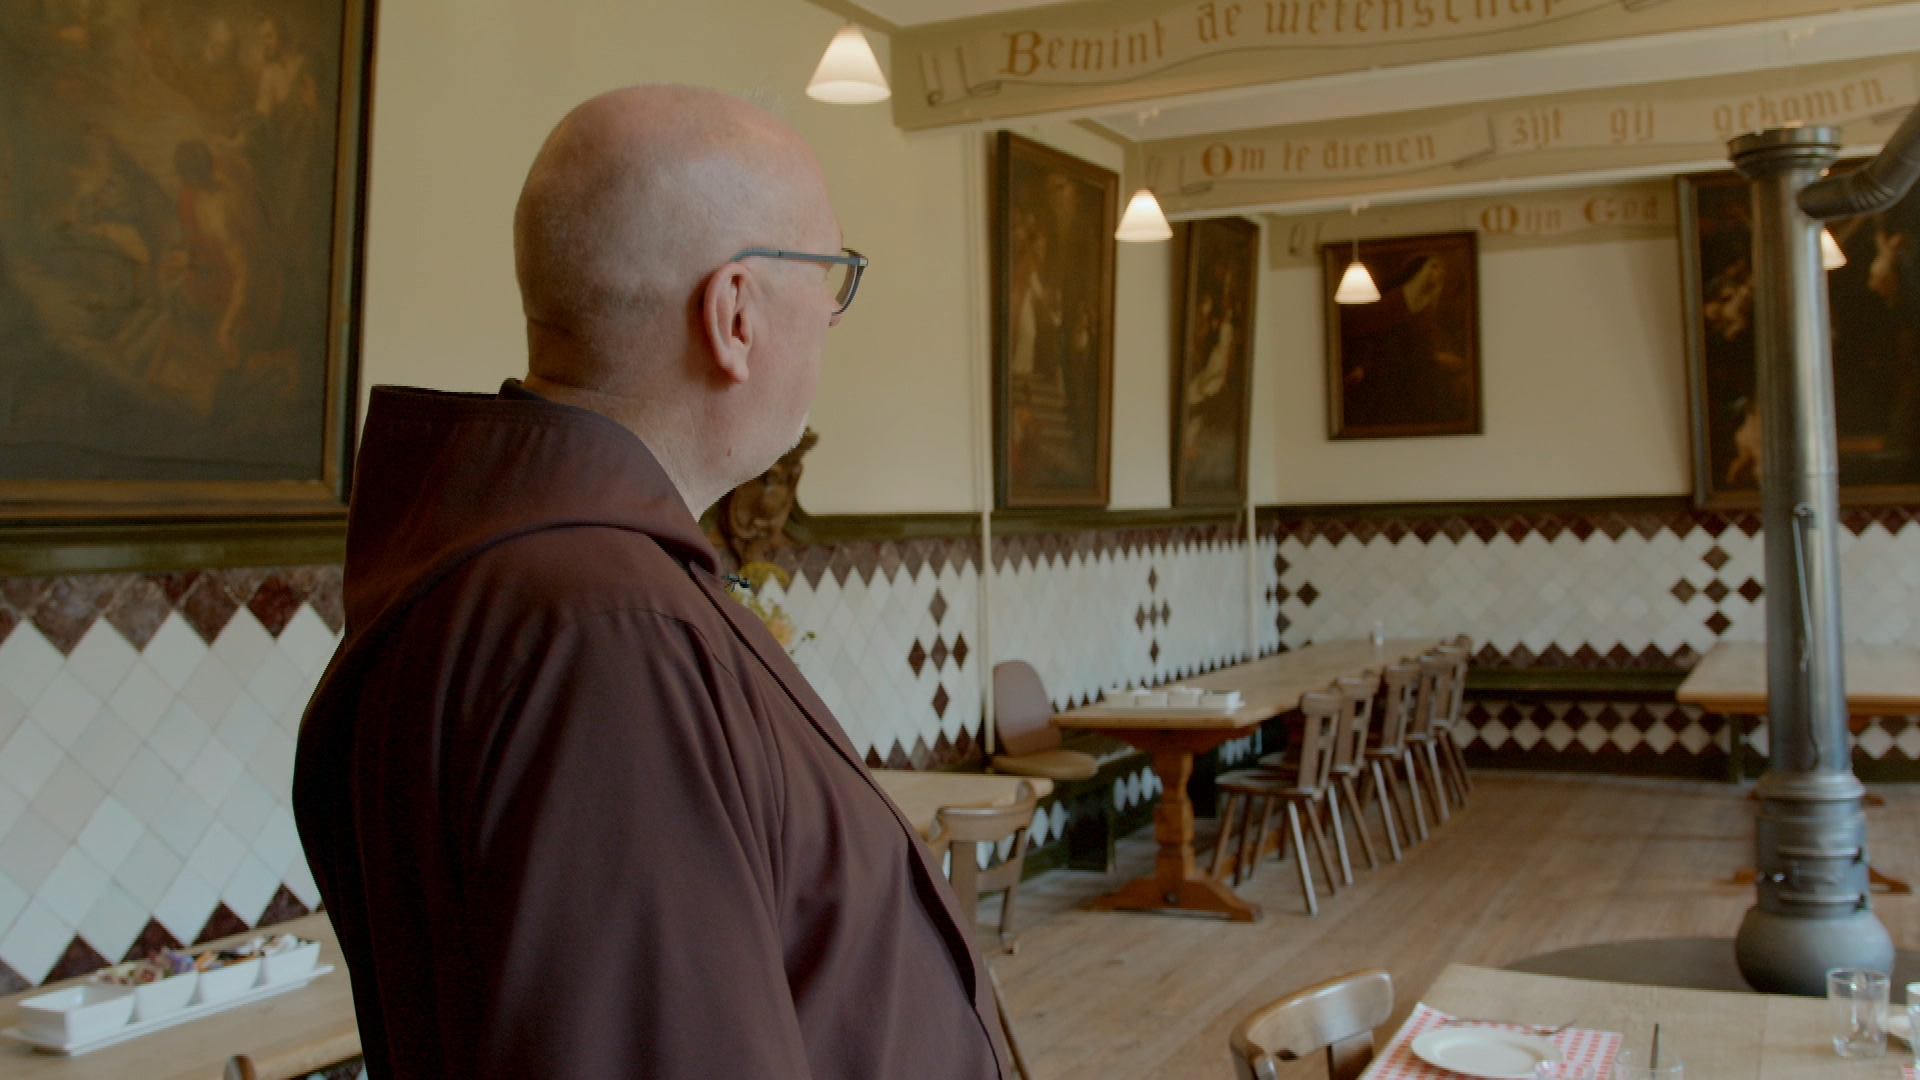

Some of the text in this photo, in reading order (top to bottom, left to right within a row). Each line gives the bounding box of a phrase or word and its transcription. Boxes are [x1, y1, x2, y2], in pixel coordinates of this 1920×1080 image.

[1001, 18, 1166, 77] Bemint
[1196, 0, 1243, 43] de
[1202, 141, 1266, 178] Om
[1283, 141, 1311, 172] te
[1322, 133, 1436, 171] dienen
[1610, 104, 1656, 145] gij
[1480, 195, 1659, 236] Mijn God
